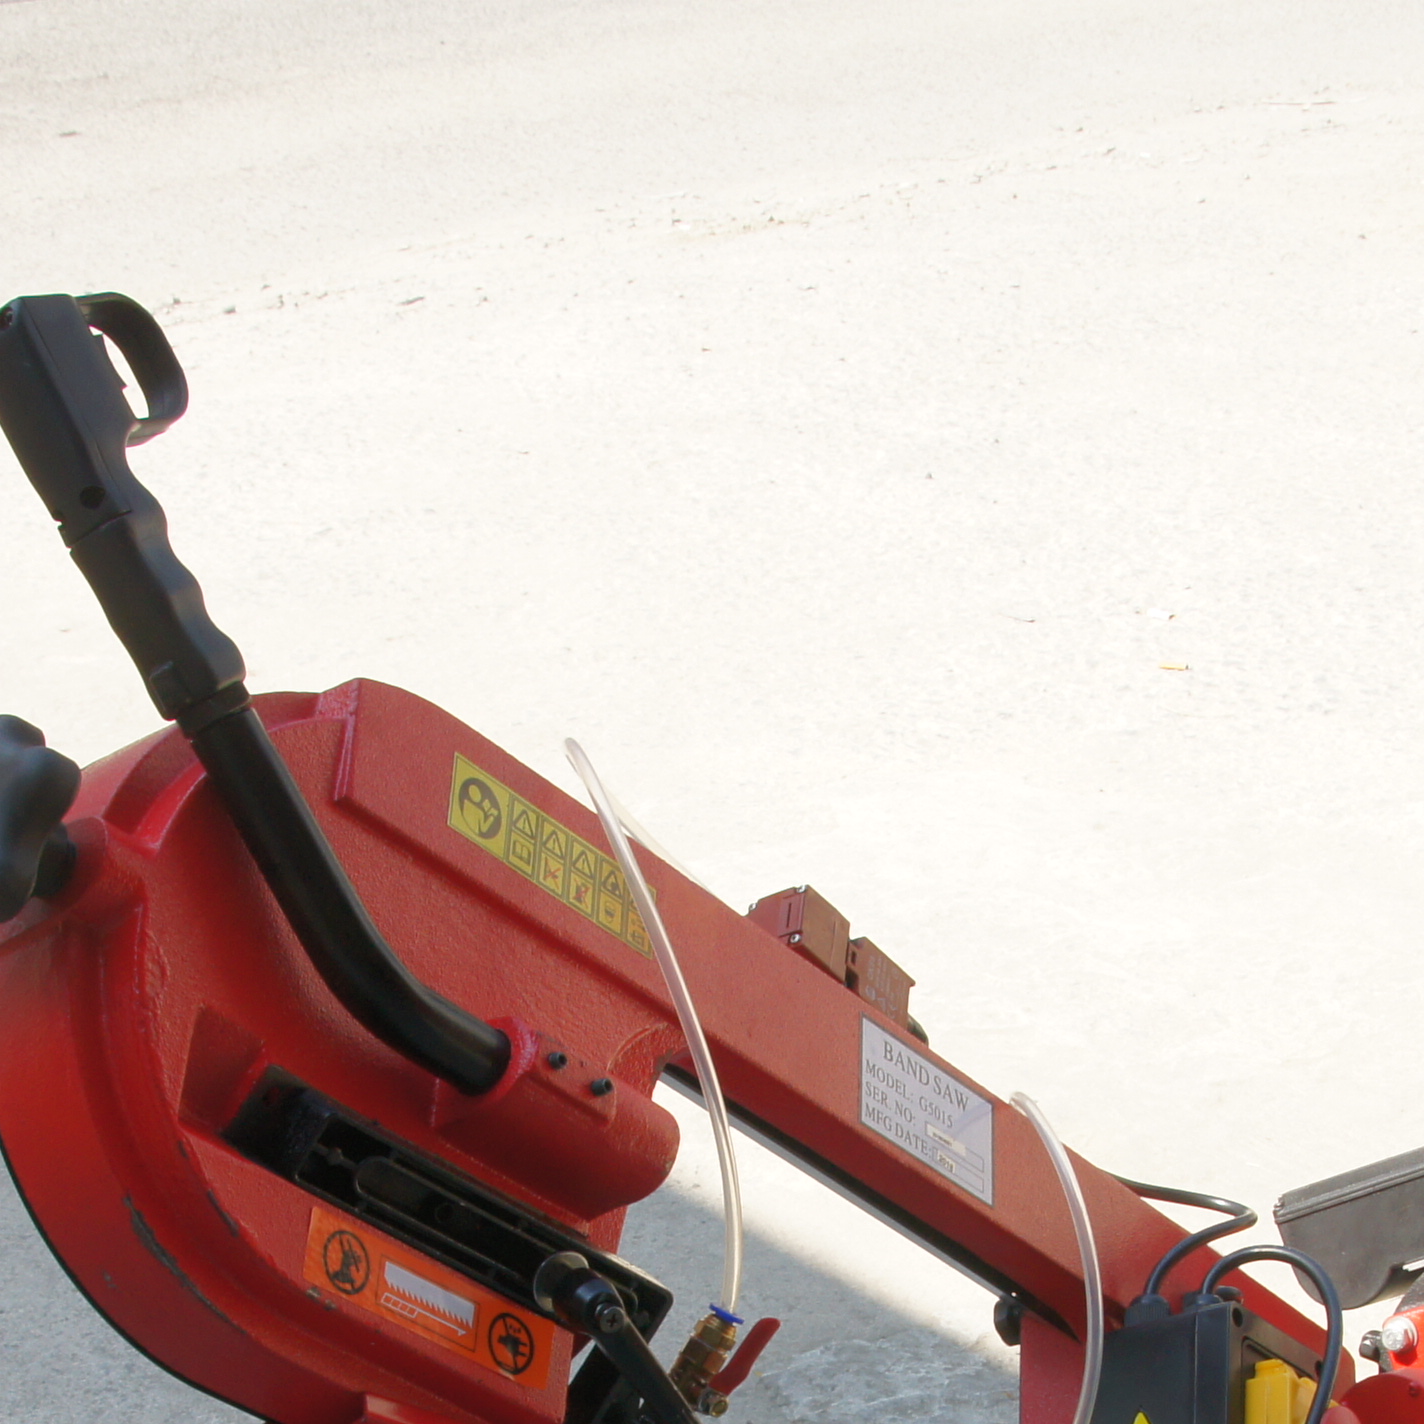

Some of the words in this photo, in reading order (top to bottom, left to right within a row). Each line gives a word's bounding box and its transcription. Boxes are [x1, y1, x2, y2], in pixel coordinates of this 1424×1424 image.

[865, 1059, 914, 1104] MODEL:
[919, 1095, 954, 1129] G5015
[865, 1081, 892, 1111] SER.
[894, 1100, 916, 1126] NO:
[883, 1041, 930, 1086] BAND
[933, 1075, 969, 1113] SAW
[865, 1102, 893, 1133] MFG
[895, 1125, 932, 1160] DATE:
